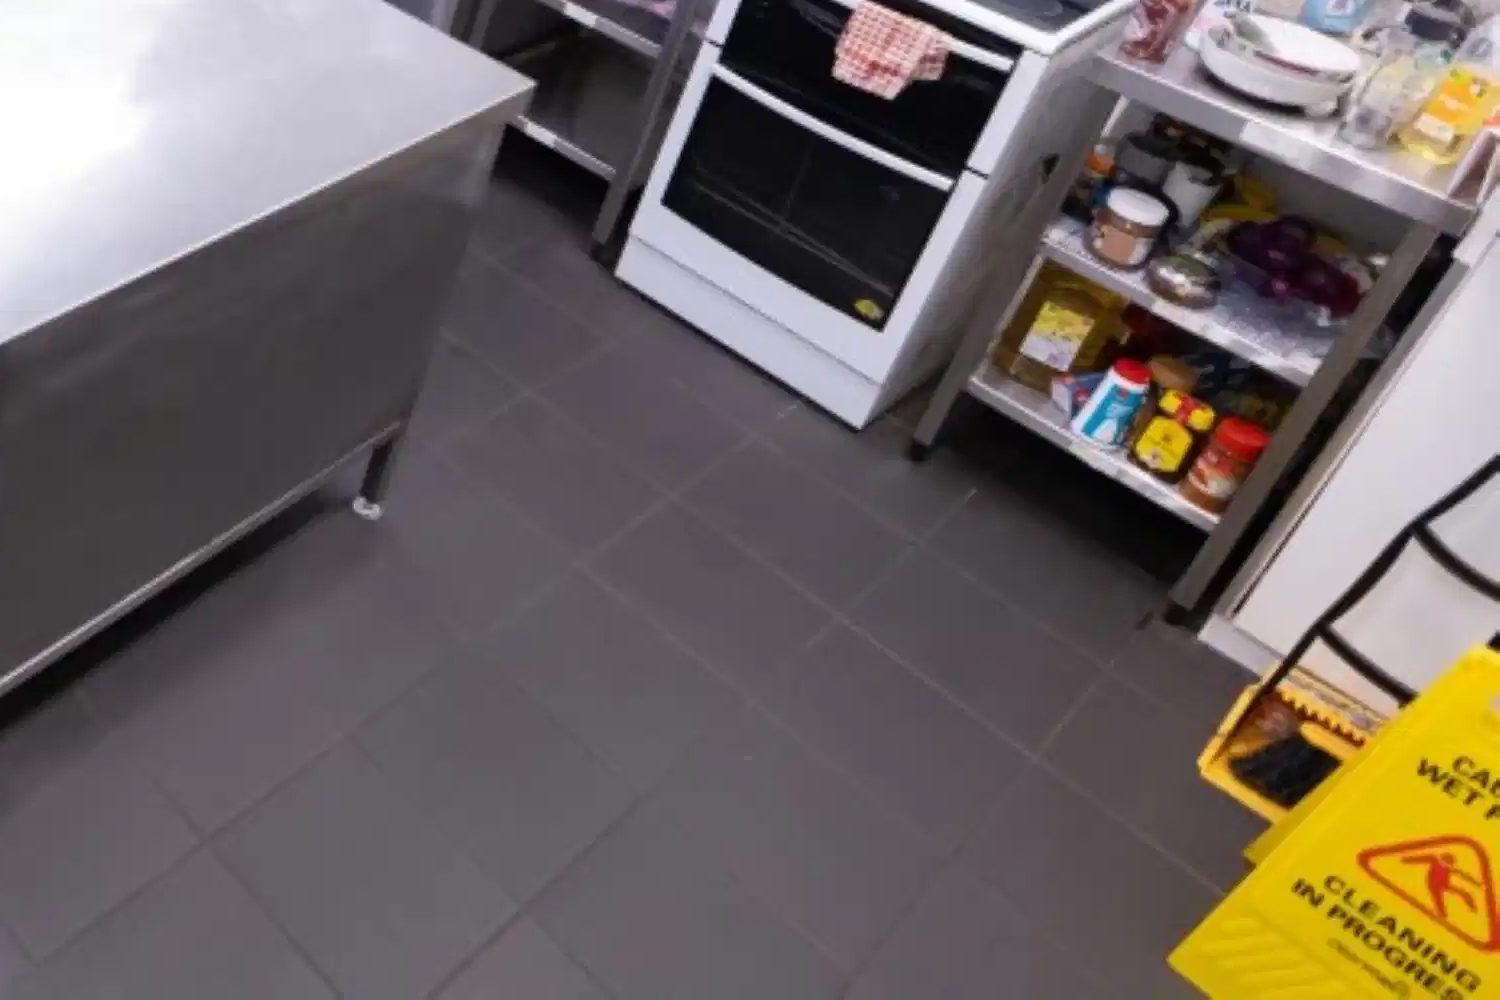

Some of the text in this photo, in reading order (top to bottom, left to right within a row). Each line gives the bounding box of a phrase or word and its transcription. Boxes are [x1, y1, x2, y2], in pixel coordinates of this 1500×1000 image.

[1416, 755, 1484, 806] WET
[1291, 877, 1325, 909] IN
[1324, 875, 1481, 993] CLEANING
